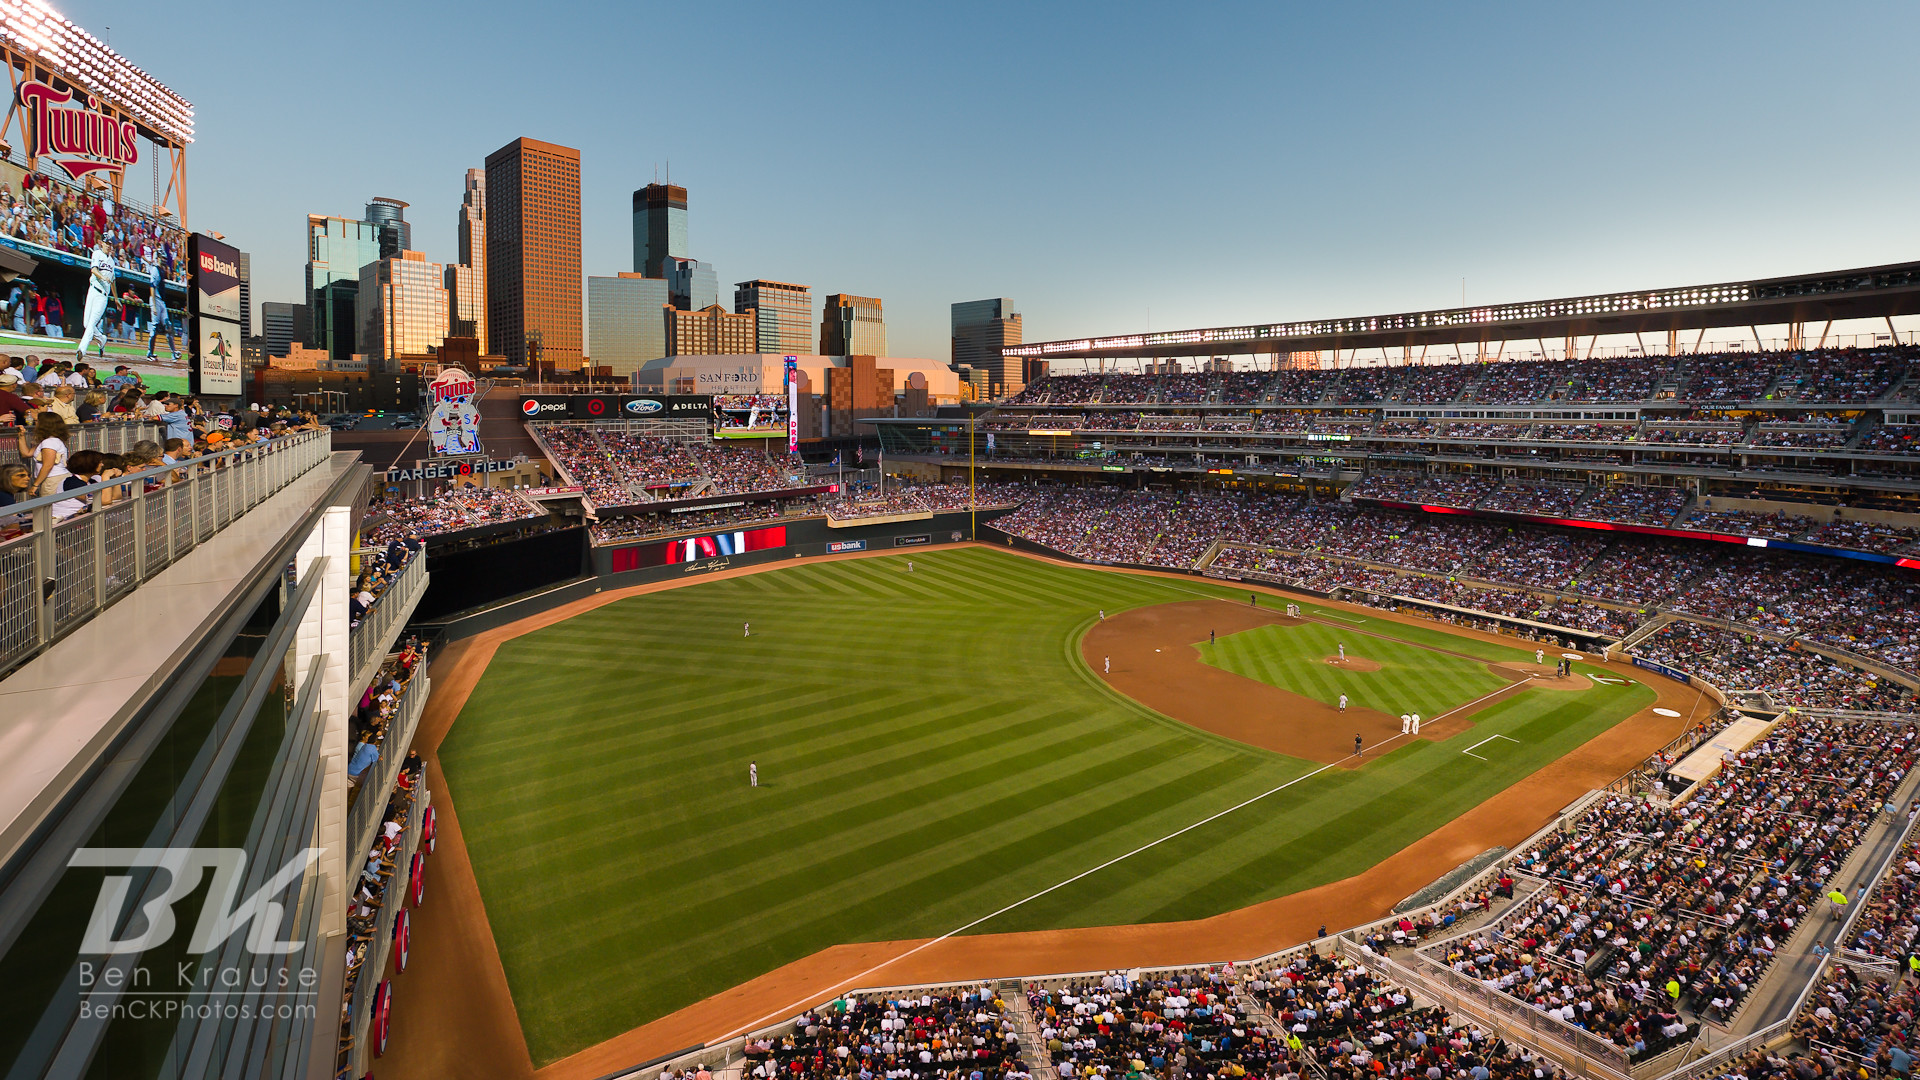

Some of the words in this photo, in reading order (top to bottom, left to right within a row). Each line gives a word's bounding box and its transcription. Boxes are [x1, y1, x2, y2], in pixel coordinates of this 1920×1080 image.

[20, 80, 138, 166] Twins
[203, 356, 222, 370] Treasure
[226, 358, 239, 371] Island
[700, 373, 757, 382] SANFORD
[430, 378, 476, 403] Twins
[540, 402, 567, 412] pepsi
[632, 401, 655, 412] Ford
[464, 413, 471, 424] S
[790, 421, 798, 452] DREW
[389, 465, 458, 482] TARGET
[474, 461, 516, 473] FIELD
